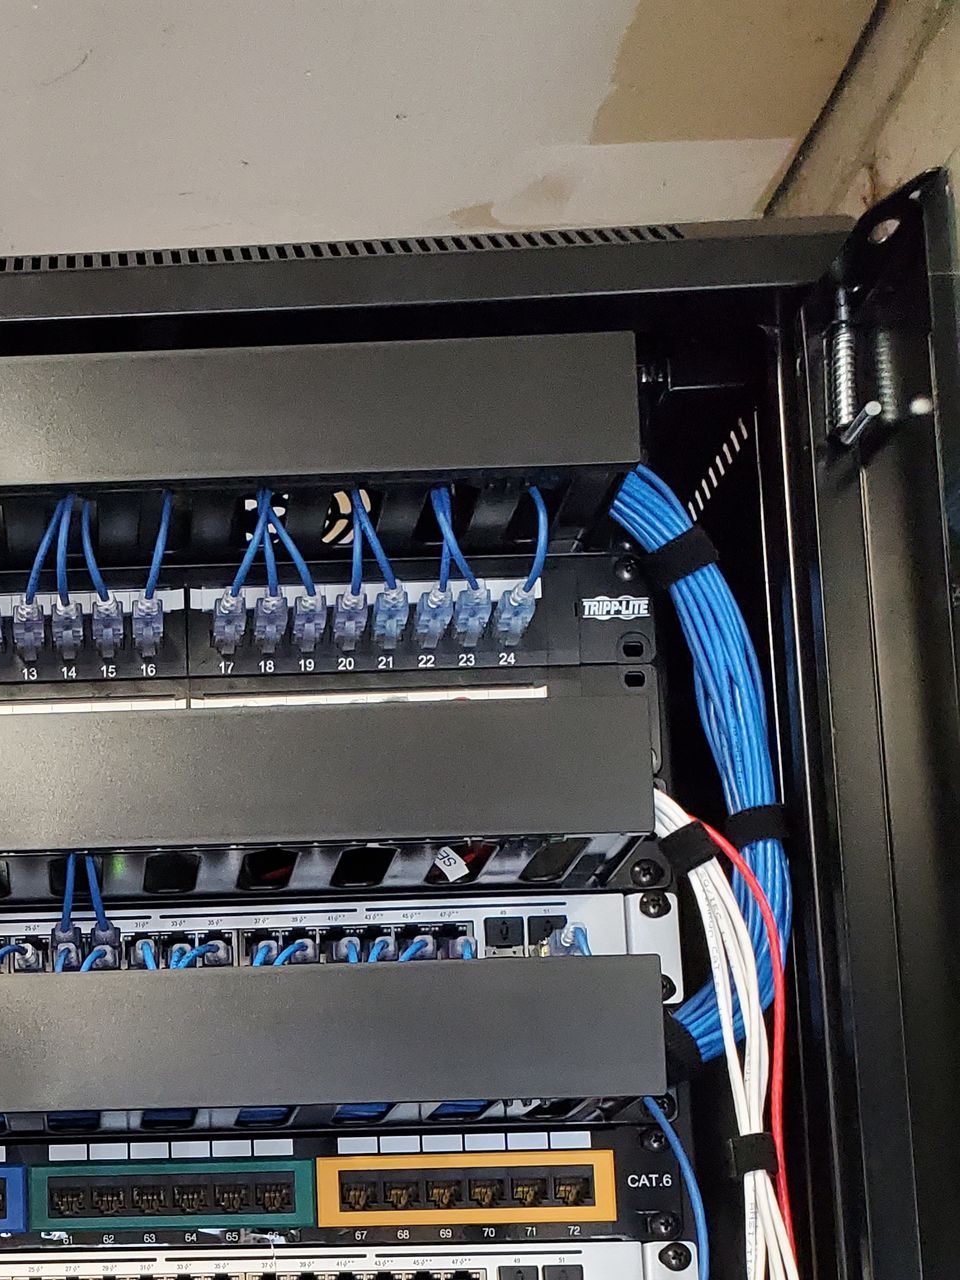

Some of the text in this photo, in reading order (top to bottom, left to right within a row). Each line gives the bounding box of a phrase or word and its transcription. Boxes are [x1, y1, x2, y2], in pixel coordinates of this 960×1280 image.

[22, 669, 37, 680] 13
[62, 667, 77, 678] 14
[101, 666, 116, 677] 15
[141, 665, 156, 676] 16
[218, 662, 234, 674] 17
[258, 661, 275, 673] 18
[299, 660, 315, 671] 19
[338, 658, 355, 670] 20
[378, 656, 394, 668] 21
[418, 655, 435, 667] 22
[459, 654, 476, 666] 23
[499, 653, 516, 665] 24
[627, 1174, 673, 1188] CAT.6
[103, 1234, 115, 1243] 62
[144, 1233, 156, 1243] 63
[185, 1232, 197, 1242] 64
[226, 1232, 238, 1241] 65
[355, 1231, 367, 1241] 67
[397, 1230, 410, 1239] 68
[440, 1229, 452, 1238] 69
[483, 1228, 495, 1237] 70
[525, 1227, 537, 1236] 71
[568, 1226, 581, 1235] 72
